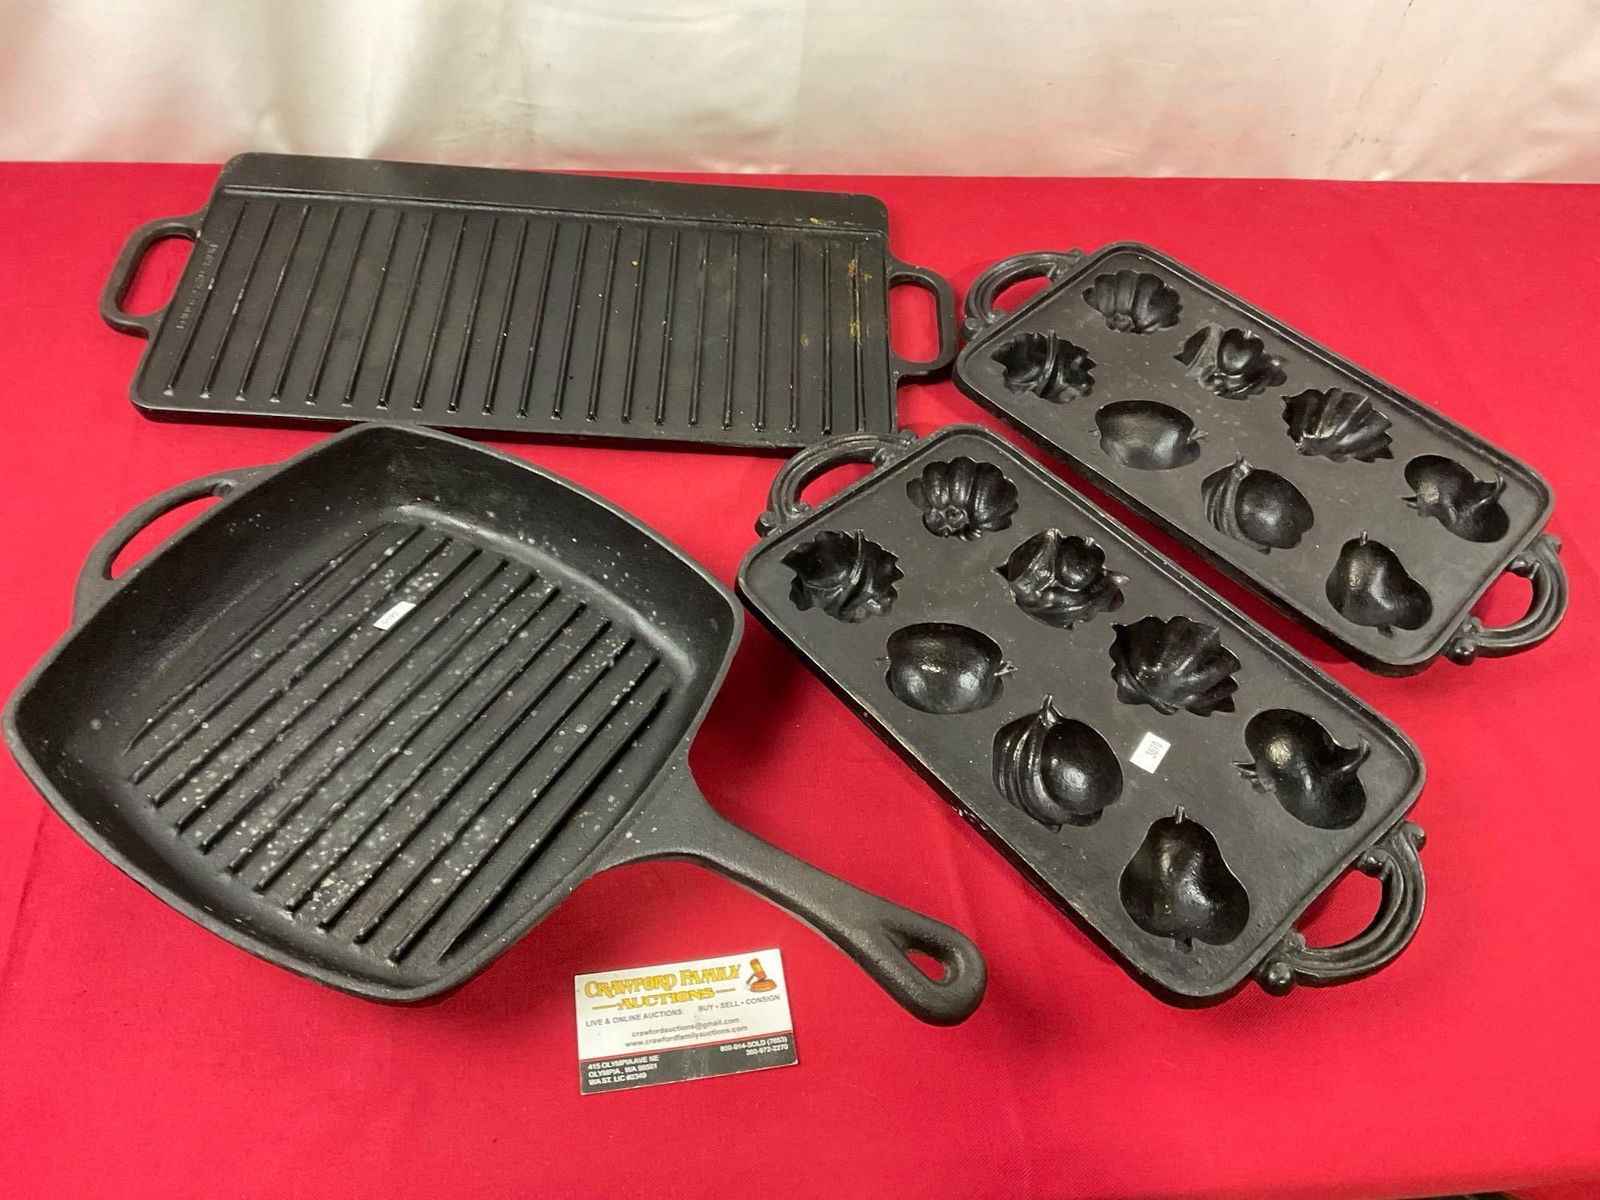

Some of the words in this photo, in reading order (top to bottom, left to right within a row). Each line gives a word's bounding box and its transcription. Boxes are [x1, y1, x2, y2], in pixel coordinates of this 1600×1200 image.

[584, 973, 677, 998] CRAWFORD
[679, 964, 742, 986] FAMILY
[617, 987, 716, 1010] AUCTIONS
[697, 1004, 714, 1012] BUY
[720, 1001, 740, 1009] SELL
[745, 994, 781, 1006] CONSIGN
[585, 1018, 603, 1027] LIVE
[604, 1017, 611, 1025] &
[612, 1012, 641, 1024] ONLINE
[642, 1008, 683, 1020] AUCTIONS
[631, 1017, 740, 1038] crawfordauctions@gmail.com
